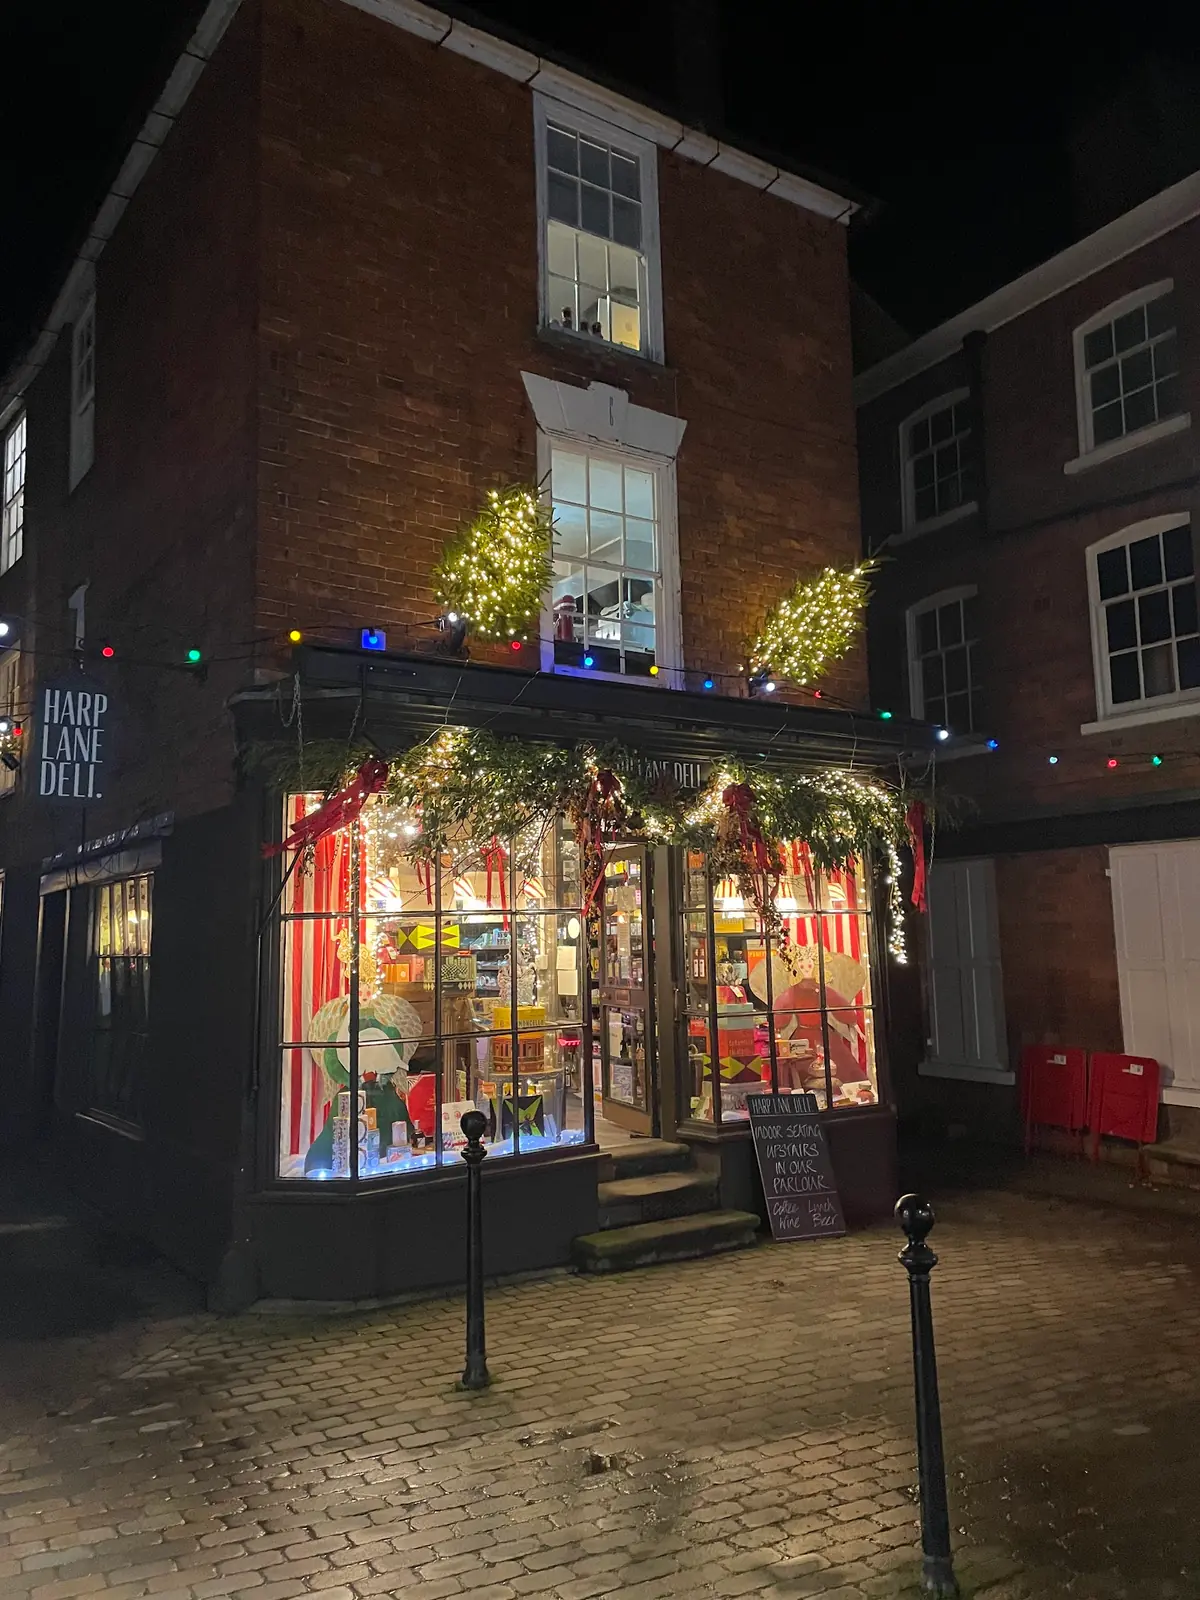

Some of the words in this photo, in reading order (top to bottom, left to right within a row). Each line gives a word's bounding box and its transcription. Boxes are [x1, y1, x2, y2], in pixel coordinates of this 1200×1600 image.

[44, 689, 108, 727] HARP
[42, 725, 105, 763] LANE
[40, 761, 102, 798] DELI.
[674, 762, 700, 788] DELI
[755, 1125, 782, 1139] INDOOR
[787, 1124, 823, 1141] SEATING
[766, 1143, 820, 1158] UPSTAIRS
[776, 1161, 786, 1174] IN
[790, 1159, 817, 1174] OUR
[774, 1175, 829, 1194] PARLOUR
